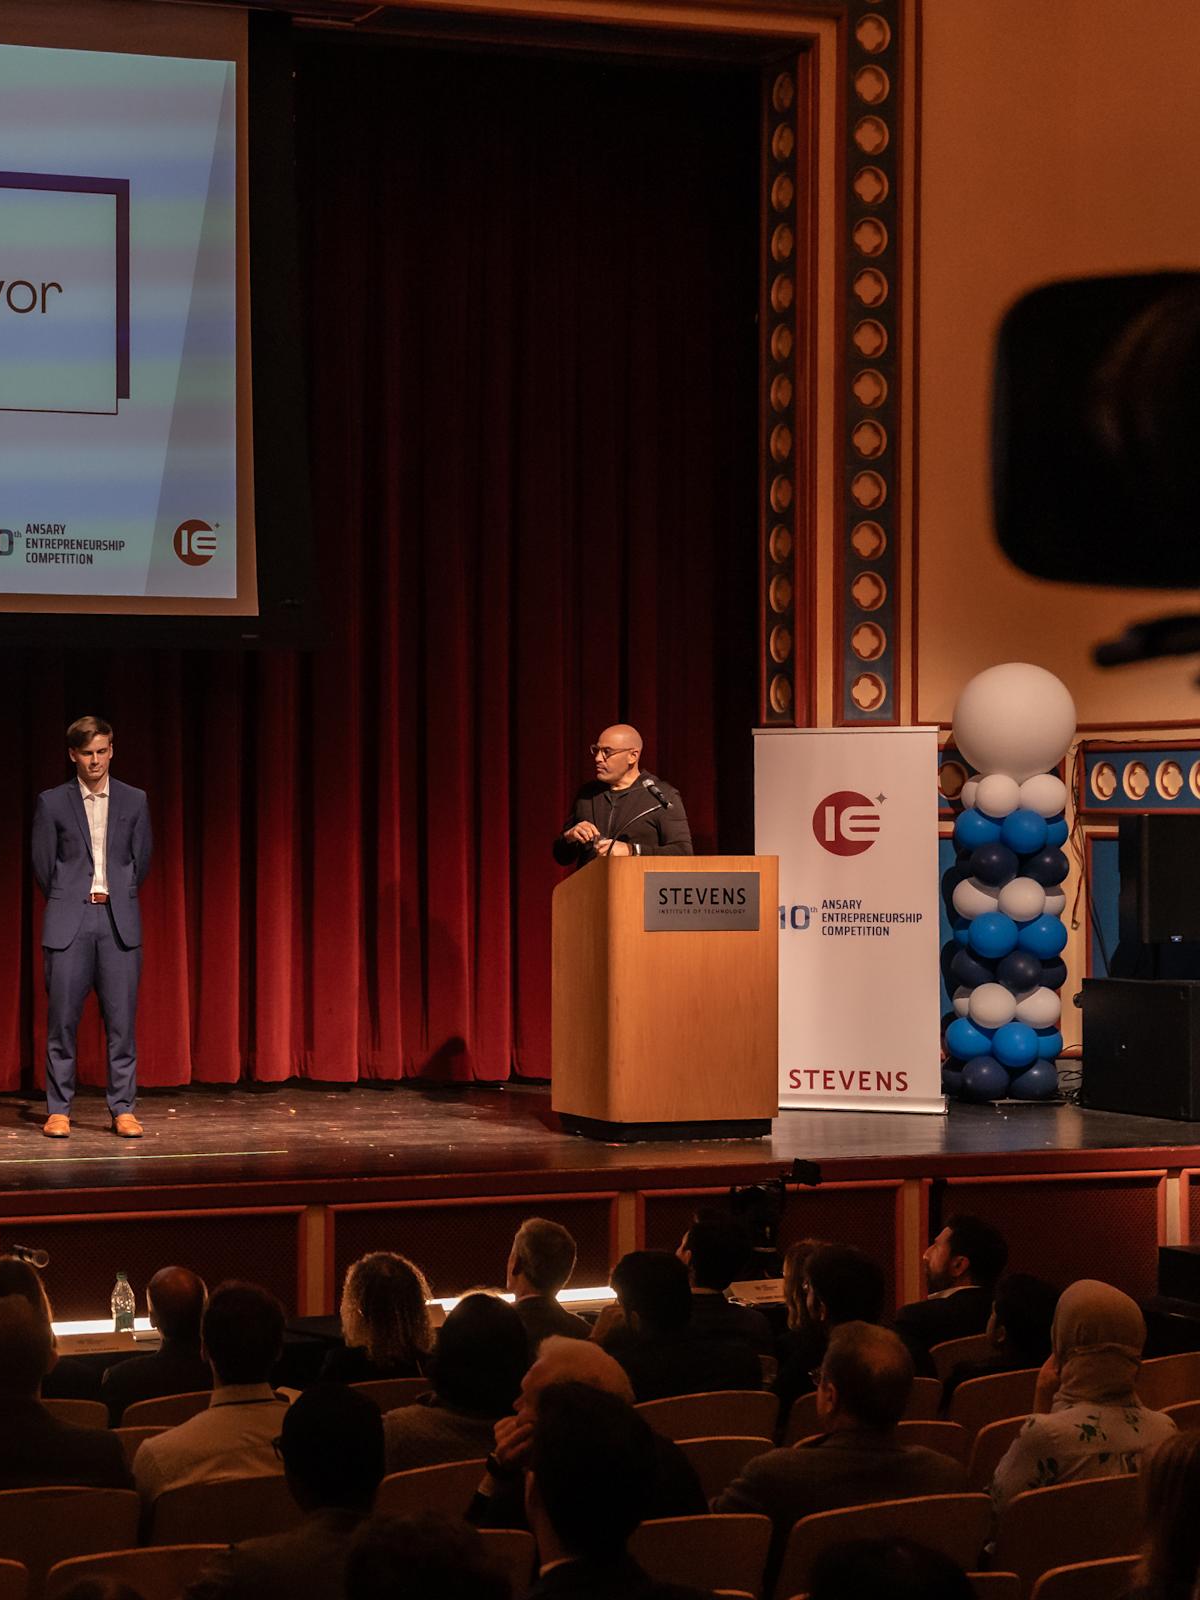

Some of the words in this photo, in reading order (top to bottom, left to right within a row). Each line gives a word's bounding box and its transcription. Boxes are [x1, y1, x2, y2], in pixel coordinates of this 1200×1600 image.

[25, 523, 66, 535] ANSARY
[25, 537, 125, 552] ENTREPRENEURSHIP
[25, 552, 93, 565] COMPETITION
[659, 887, 746, 905] STEVENS
[821, 899, 862, 910] ANSARY
[821, 912, 923, 923] ENTREPRENEURSHIP
[821, 925, 890, 936] COMPETITION
[788, 1069, 909, 1092] STEVENS
